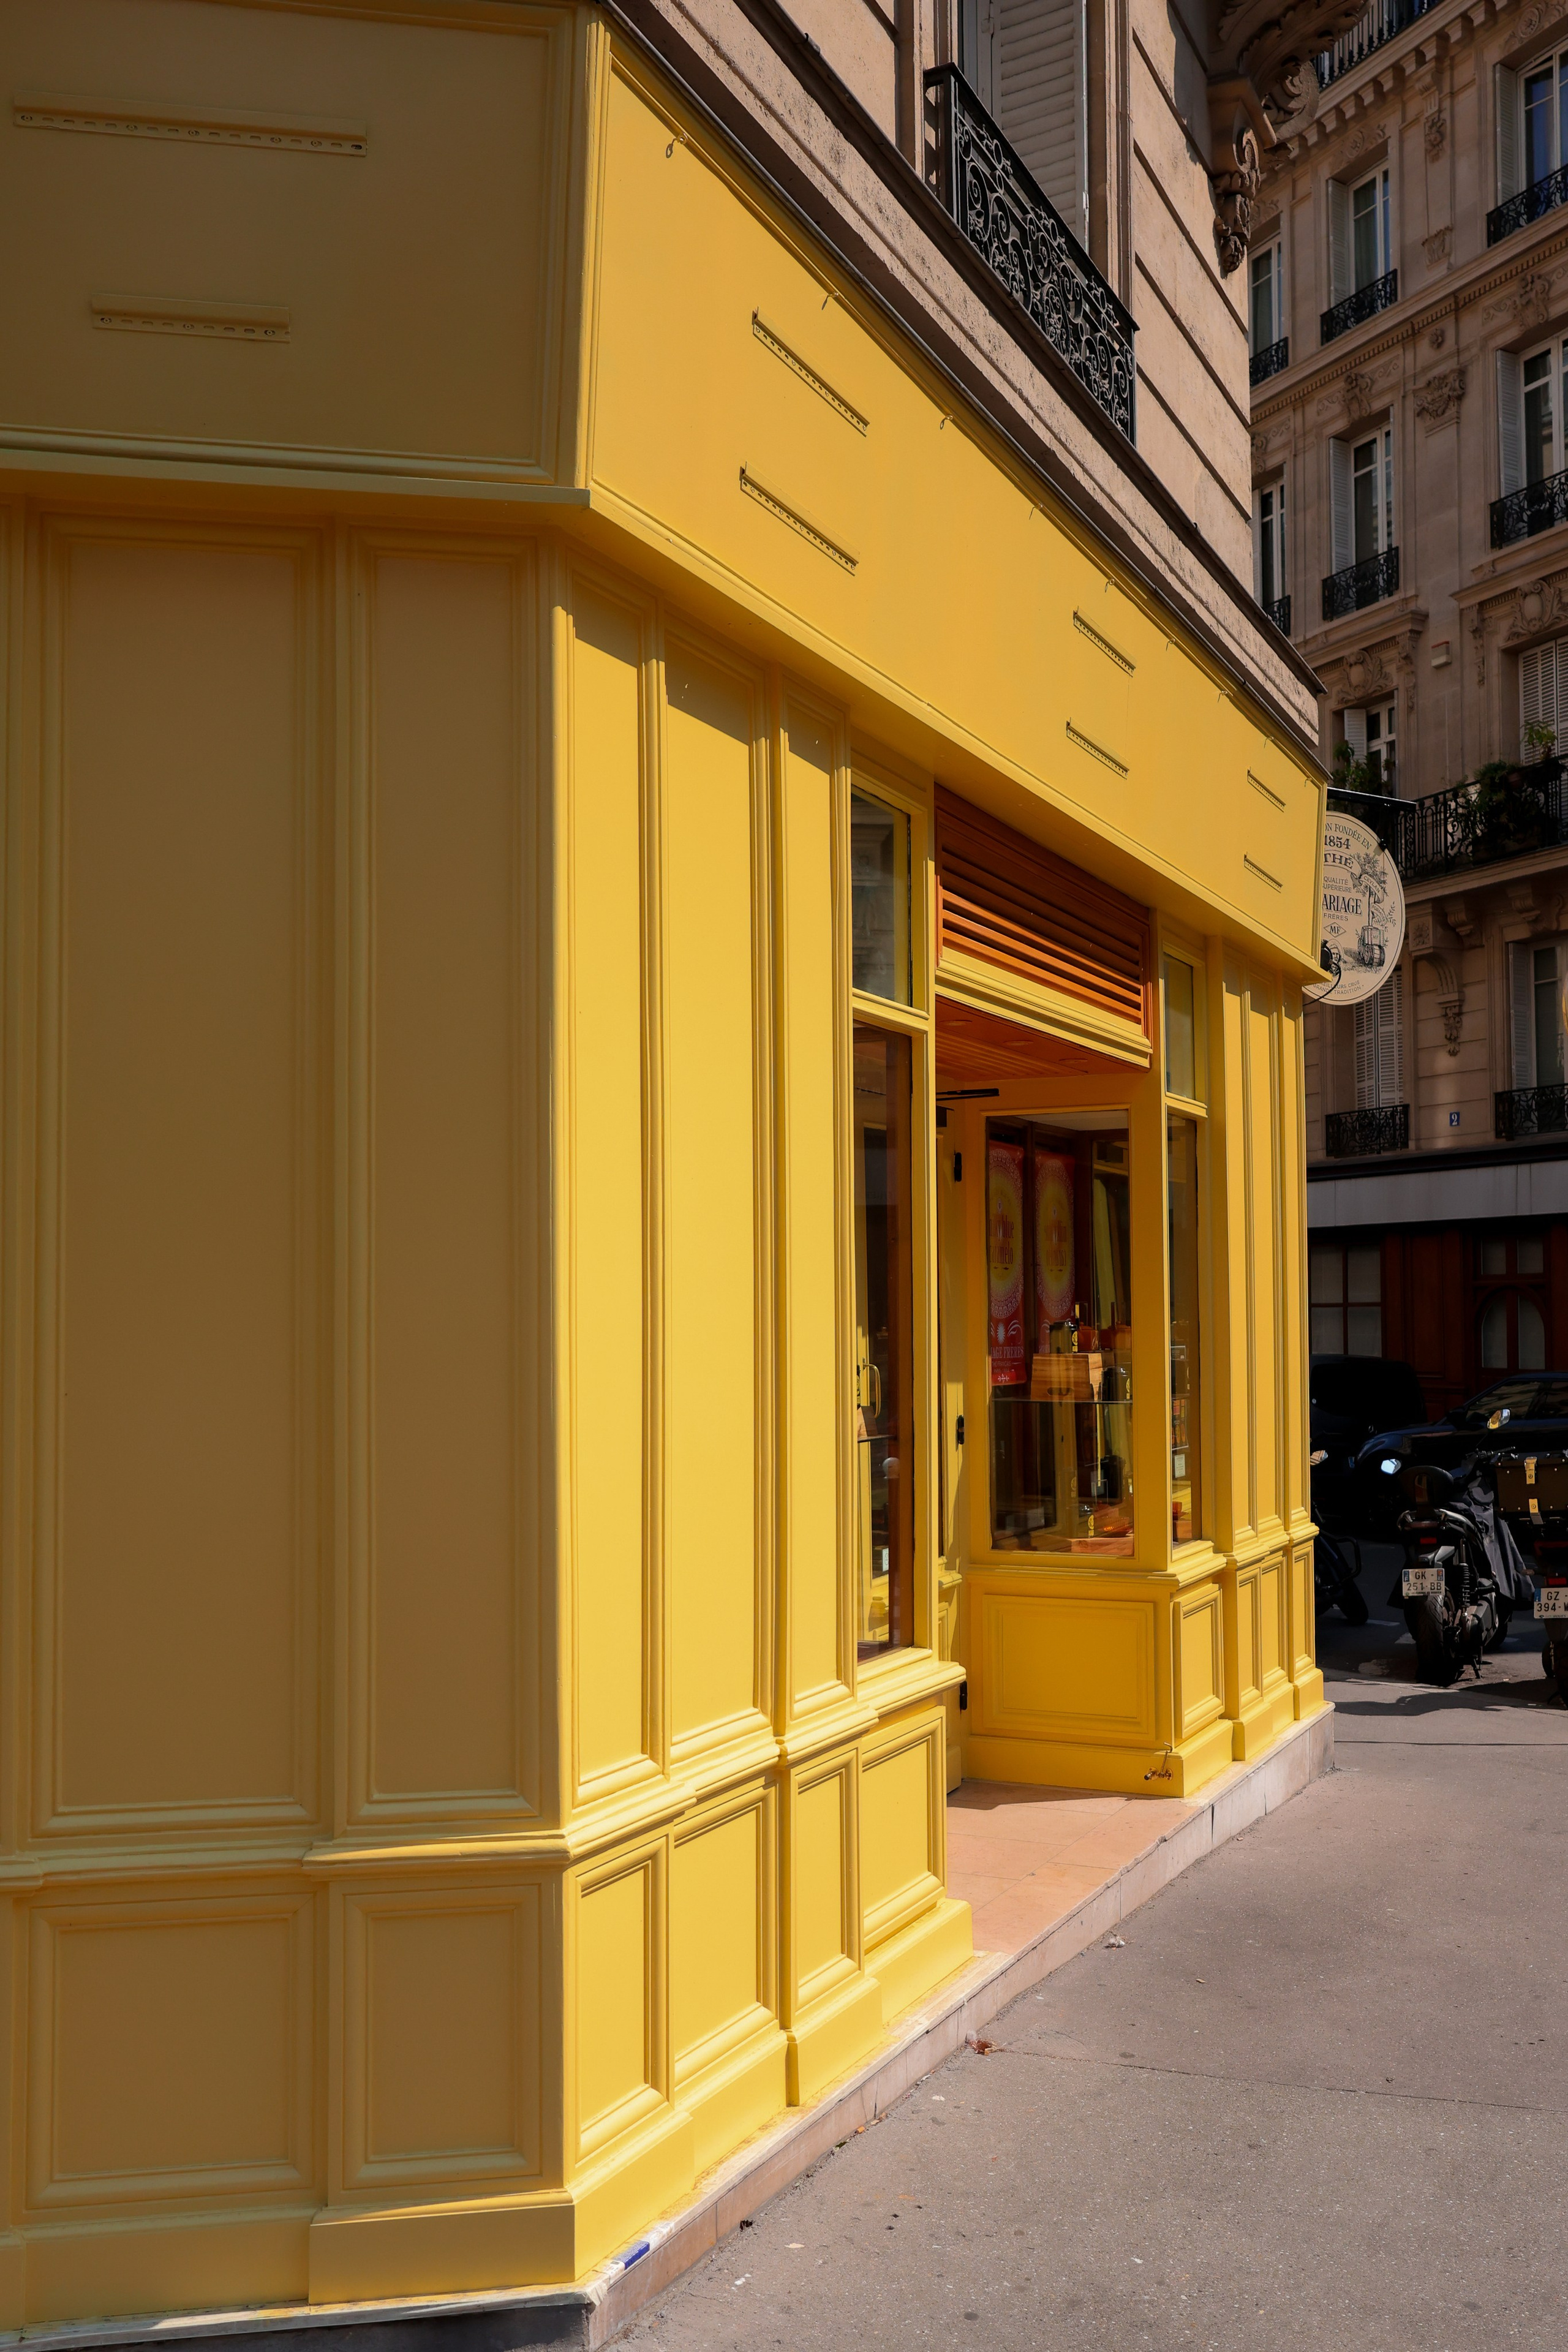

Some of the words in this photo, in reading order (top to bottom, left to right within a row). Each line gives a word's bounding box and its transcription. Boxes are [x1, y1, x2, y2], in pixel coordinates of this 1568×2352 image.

[1334, 823, 1362, 842] FONDÉE
[1361, 837, 1372, 850] EN
[1324, 835, 1351, 850] 1854
[1324, 876, 1349, 885] QUALITÉ
[1363, 875, 1381, 894] CEYLAN
[1322, 894, 1362, 914] ARIAGE
[1330, 925, 1341, 934] MF
[1313, 984, 1332, 993] GRAND
[1452, 1113, 1458, 1125] 2
[990, 1241, 1013, 1265] aramelo
[1415, 1571, 1427, 1580] GK
[1406, 1582, 1442, 1591] 251-BB
[1547, 1591, 1559, 1600] GZ
